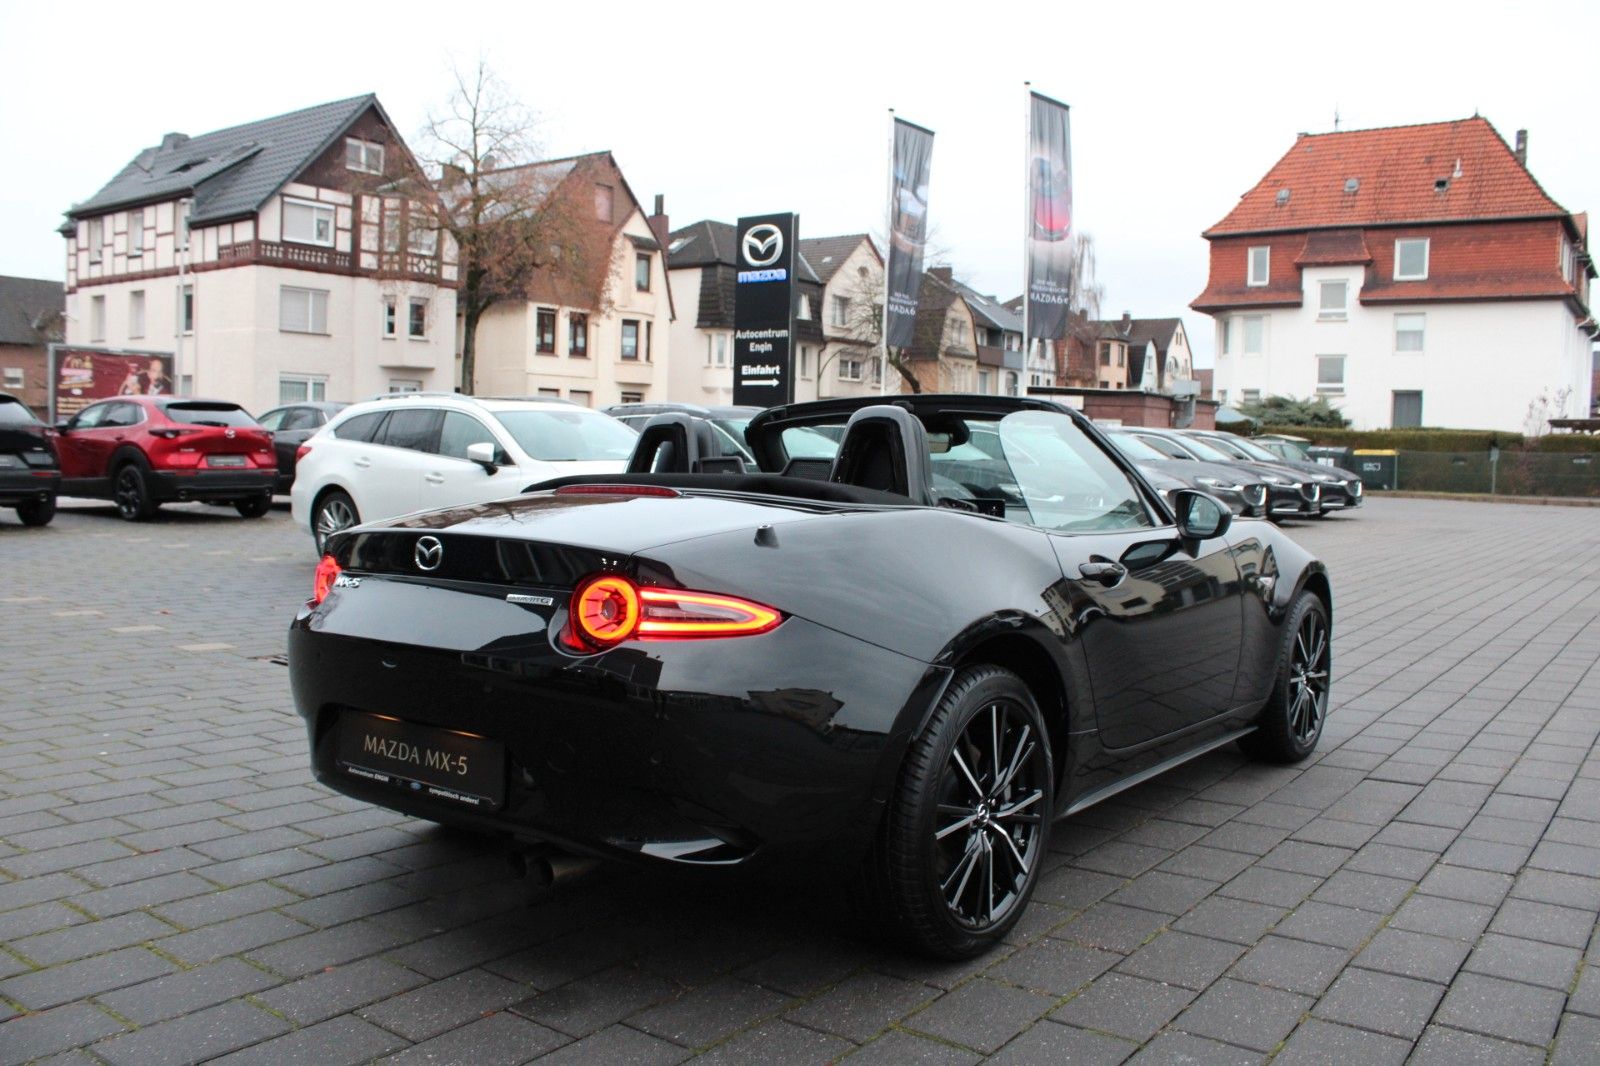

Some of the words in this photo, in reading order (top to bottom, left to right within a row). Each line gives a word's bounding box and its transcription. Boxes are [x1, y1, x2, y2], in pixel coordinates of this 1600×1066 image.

[738, 268, 787, 283] mazda
[736, 328, 788, 339] Autocentrum
[749, 341, 773, 354] Engin
[742, 364, 781, 376] Einfahrt
[364, 734, 420, 765] MAZDA
[425, 749, 468, 775] MX-5
